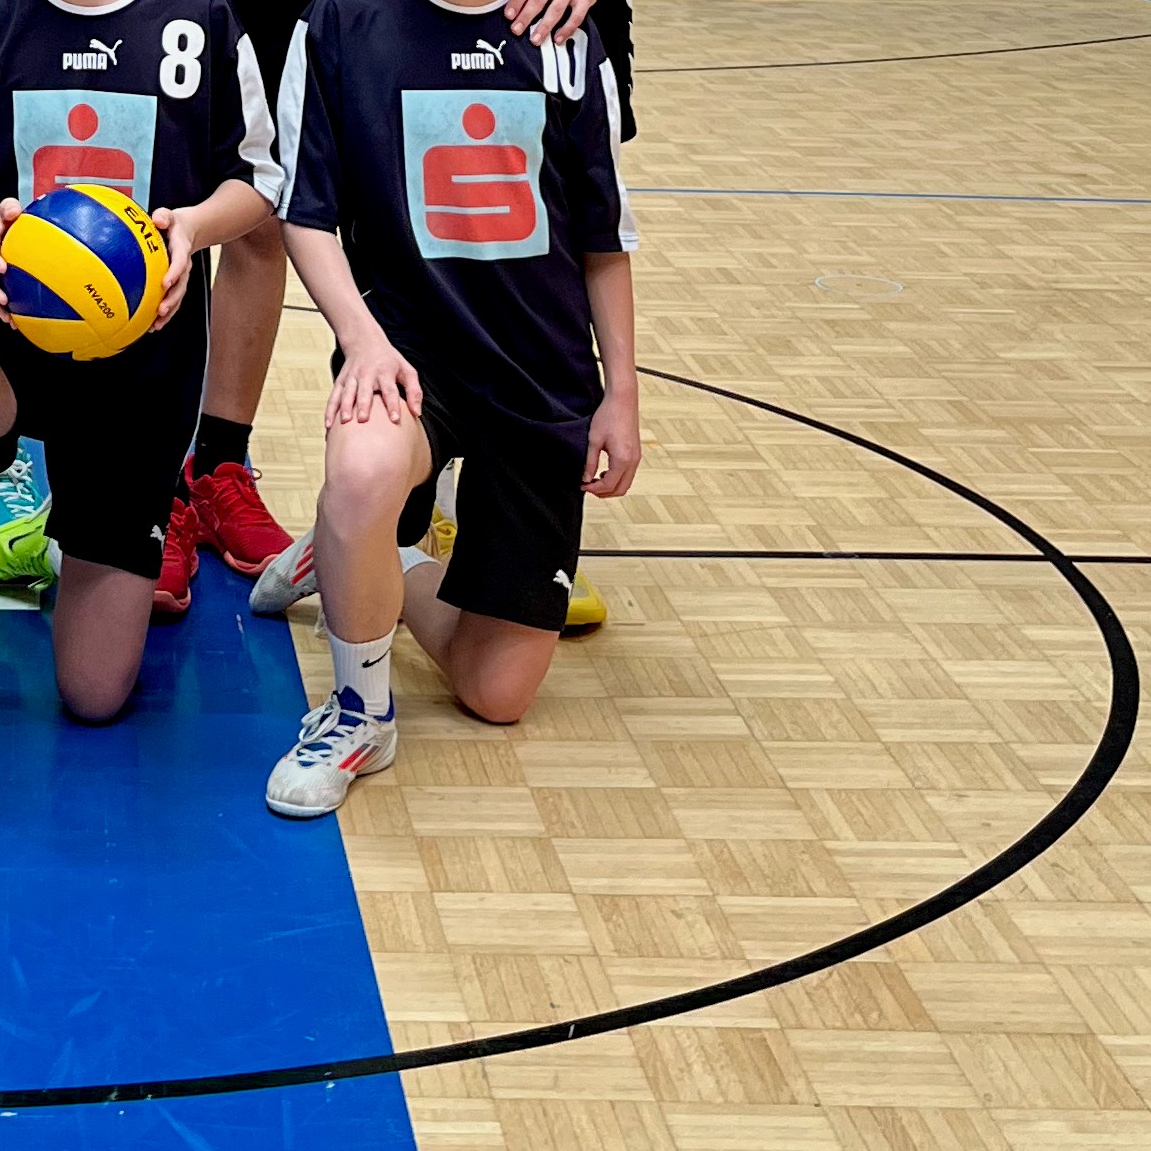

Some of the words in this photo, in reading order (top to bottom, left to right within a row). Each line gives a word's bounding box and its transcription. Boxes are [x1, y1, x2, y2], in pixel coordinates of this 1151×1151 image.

[62, 52, 108, 71] PUMA
[159, 19, 203, 99] 8
[451, 53, 495, 70] PUMA
[530, 18, 589, 101] 10
[84, 283, 115, 319] MVA200
